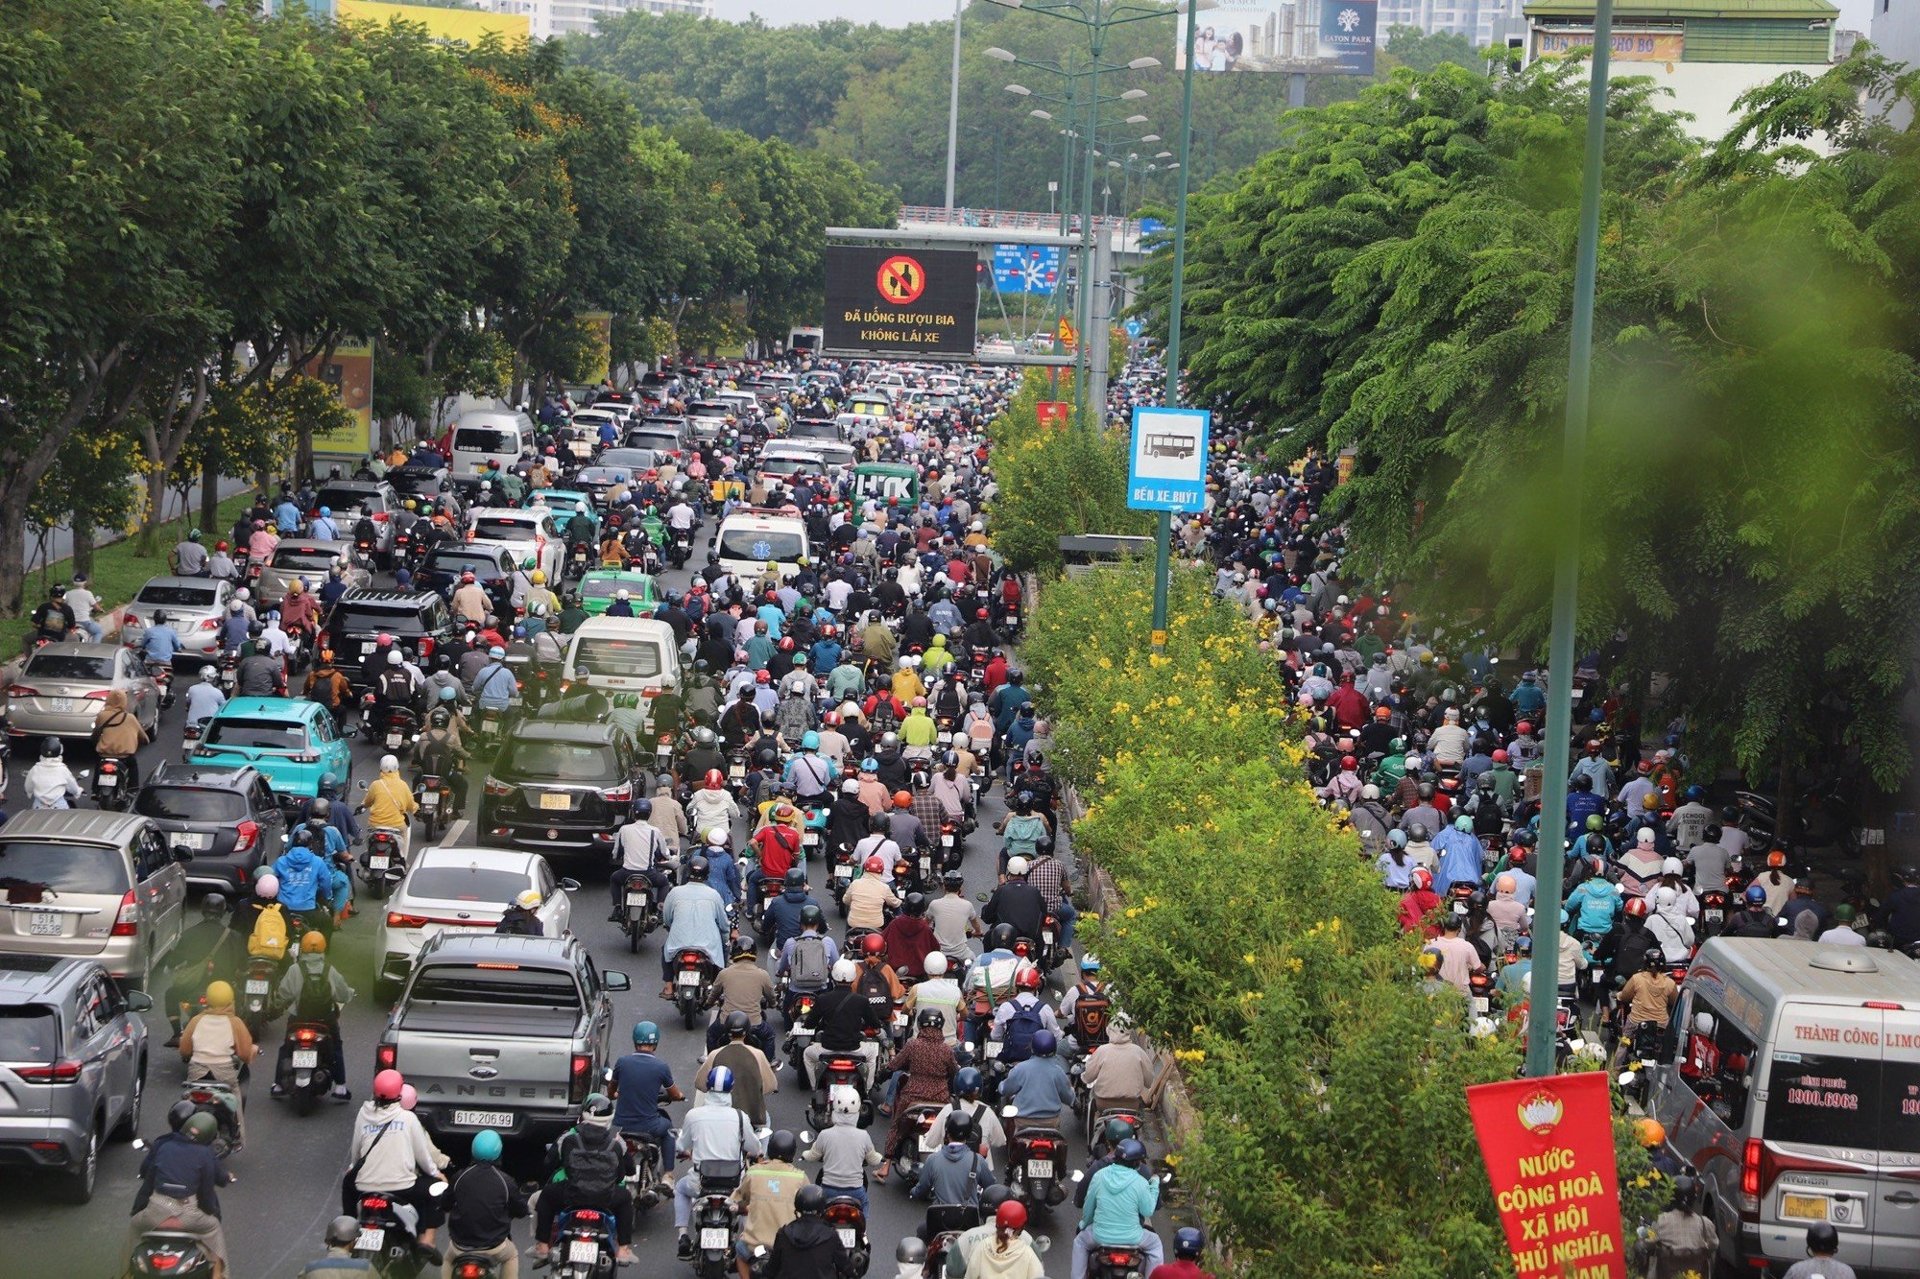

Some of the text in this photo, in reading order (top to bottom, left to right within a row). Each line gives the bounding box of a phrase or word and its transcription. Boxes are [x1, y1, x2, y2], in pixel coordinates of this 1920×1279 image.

[1325, 35, 1350, 43] EATON
[844, 306, 955, 326] ĐÃ UỐNG RƯỢU BIA
[861, 328, 939, 343] KHÔNG LÁI XE
[1134, 485, 1198, 504] BẾN XE BUÝT
[1682, 812, 1706, 820] SCHOOL
[1795, 1024, 1839, 1042] THÀNH
[1843, 1027, 1879, 1045] CÔNG
[425, 1084, 567, 1100] ANGER
[1788, 1087, 1858, 1109] 1900.6962
[1519, 1147, 1575, 1178] NƯỚC
[1783, 1175, 1829, 1187] HYUNDAI
[1497, 1171, 1604, 1214] CỘNG HOÀ
[1520, 1204, 1588, 1241] XÃ HỘI
[1552, 1230, 1614, 1264] NGHĨA
